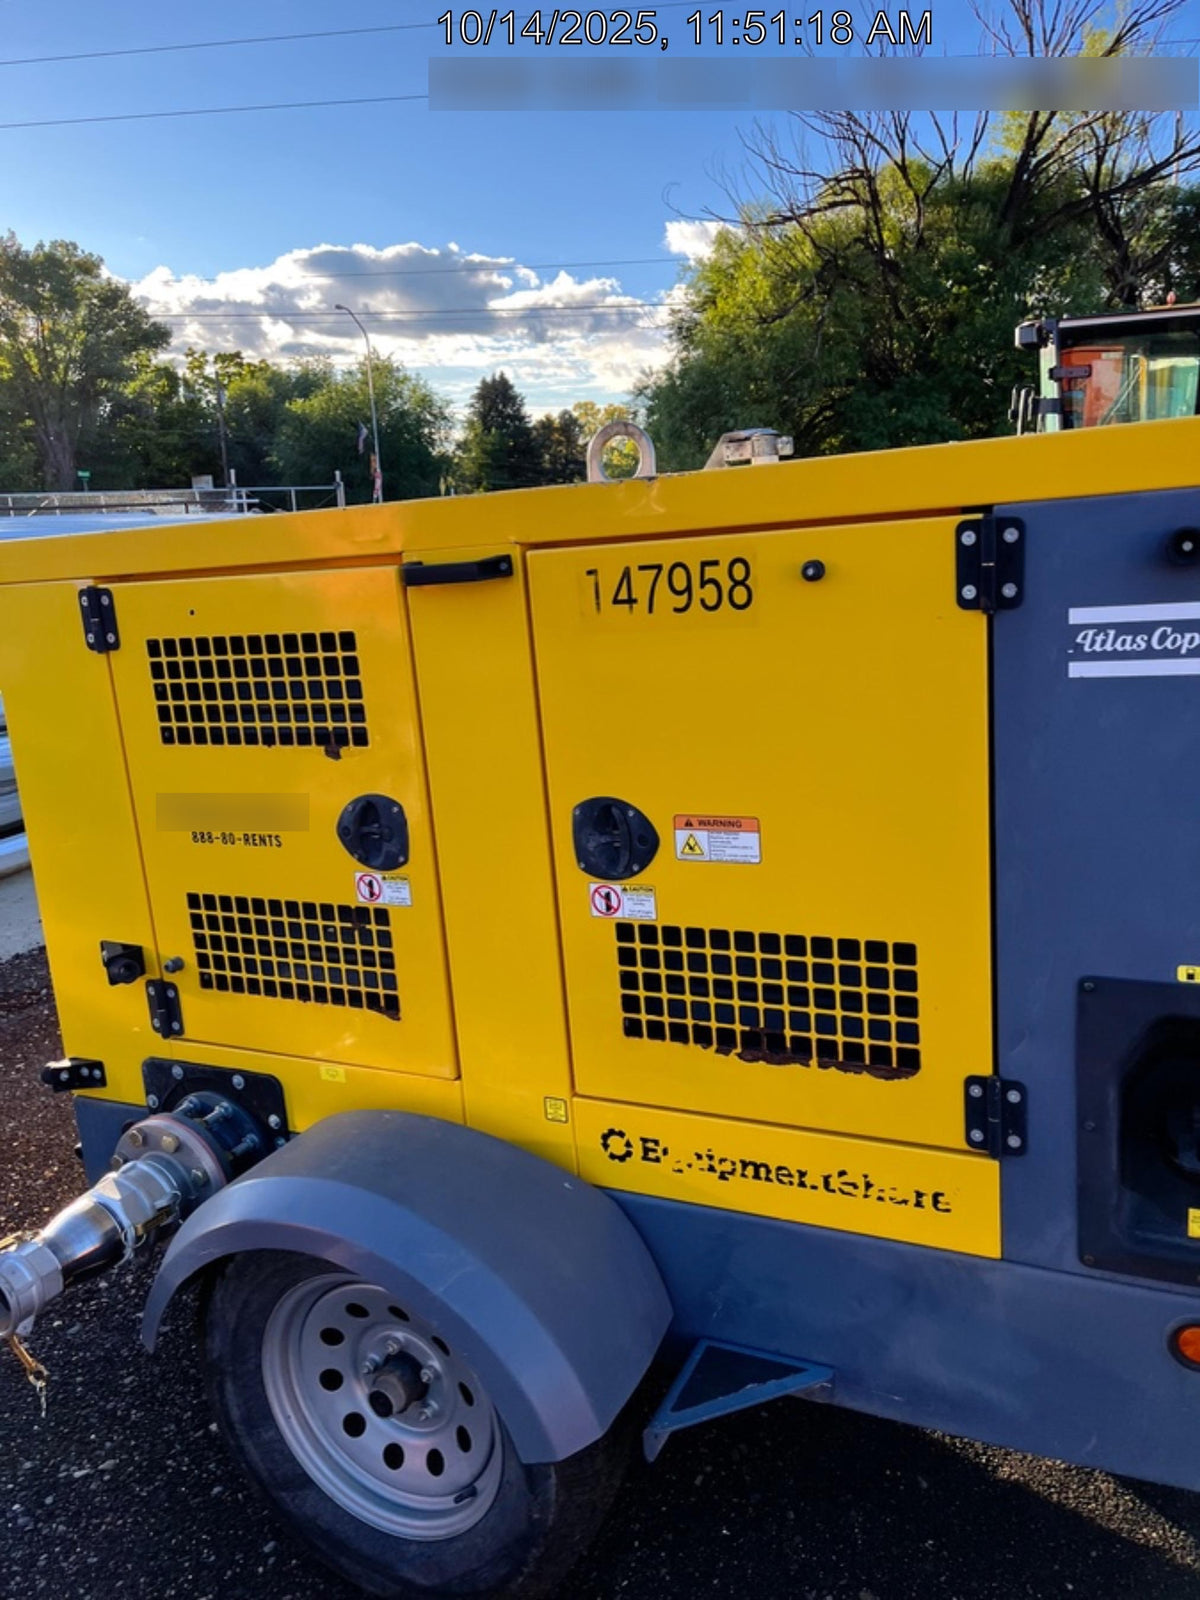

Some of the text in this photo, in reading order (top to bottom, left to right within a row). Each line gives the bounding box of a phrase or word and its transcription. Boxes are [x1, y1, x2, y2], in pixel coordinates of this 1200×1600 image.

[585, 557, 753, 615] 147958
[1075, 628, 1148, 653] Atlas
[696, 818, 743, 829] WARNING
[191, 831, 283, 848] 888-80-RENTS
